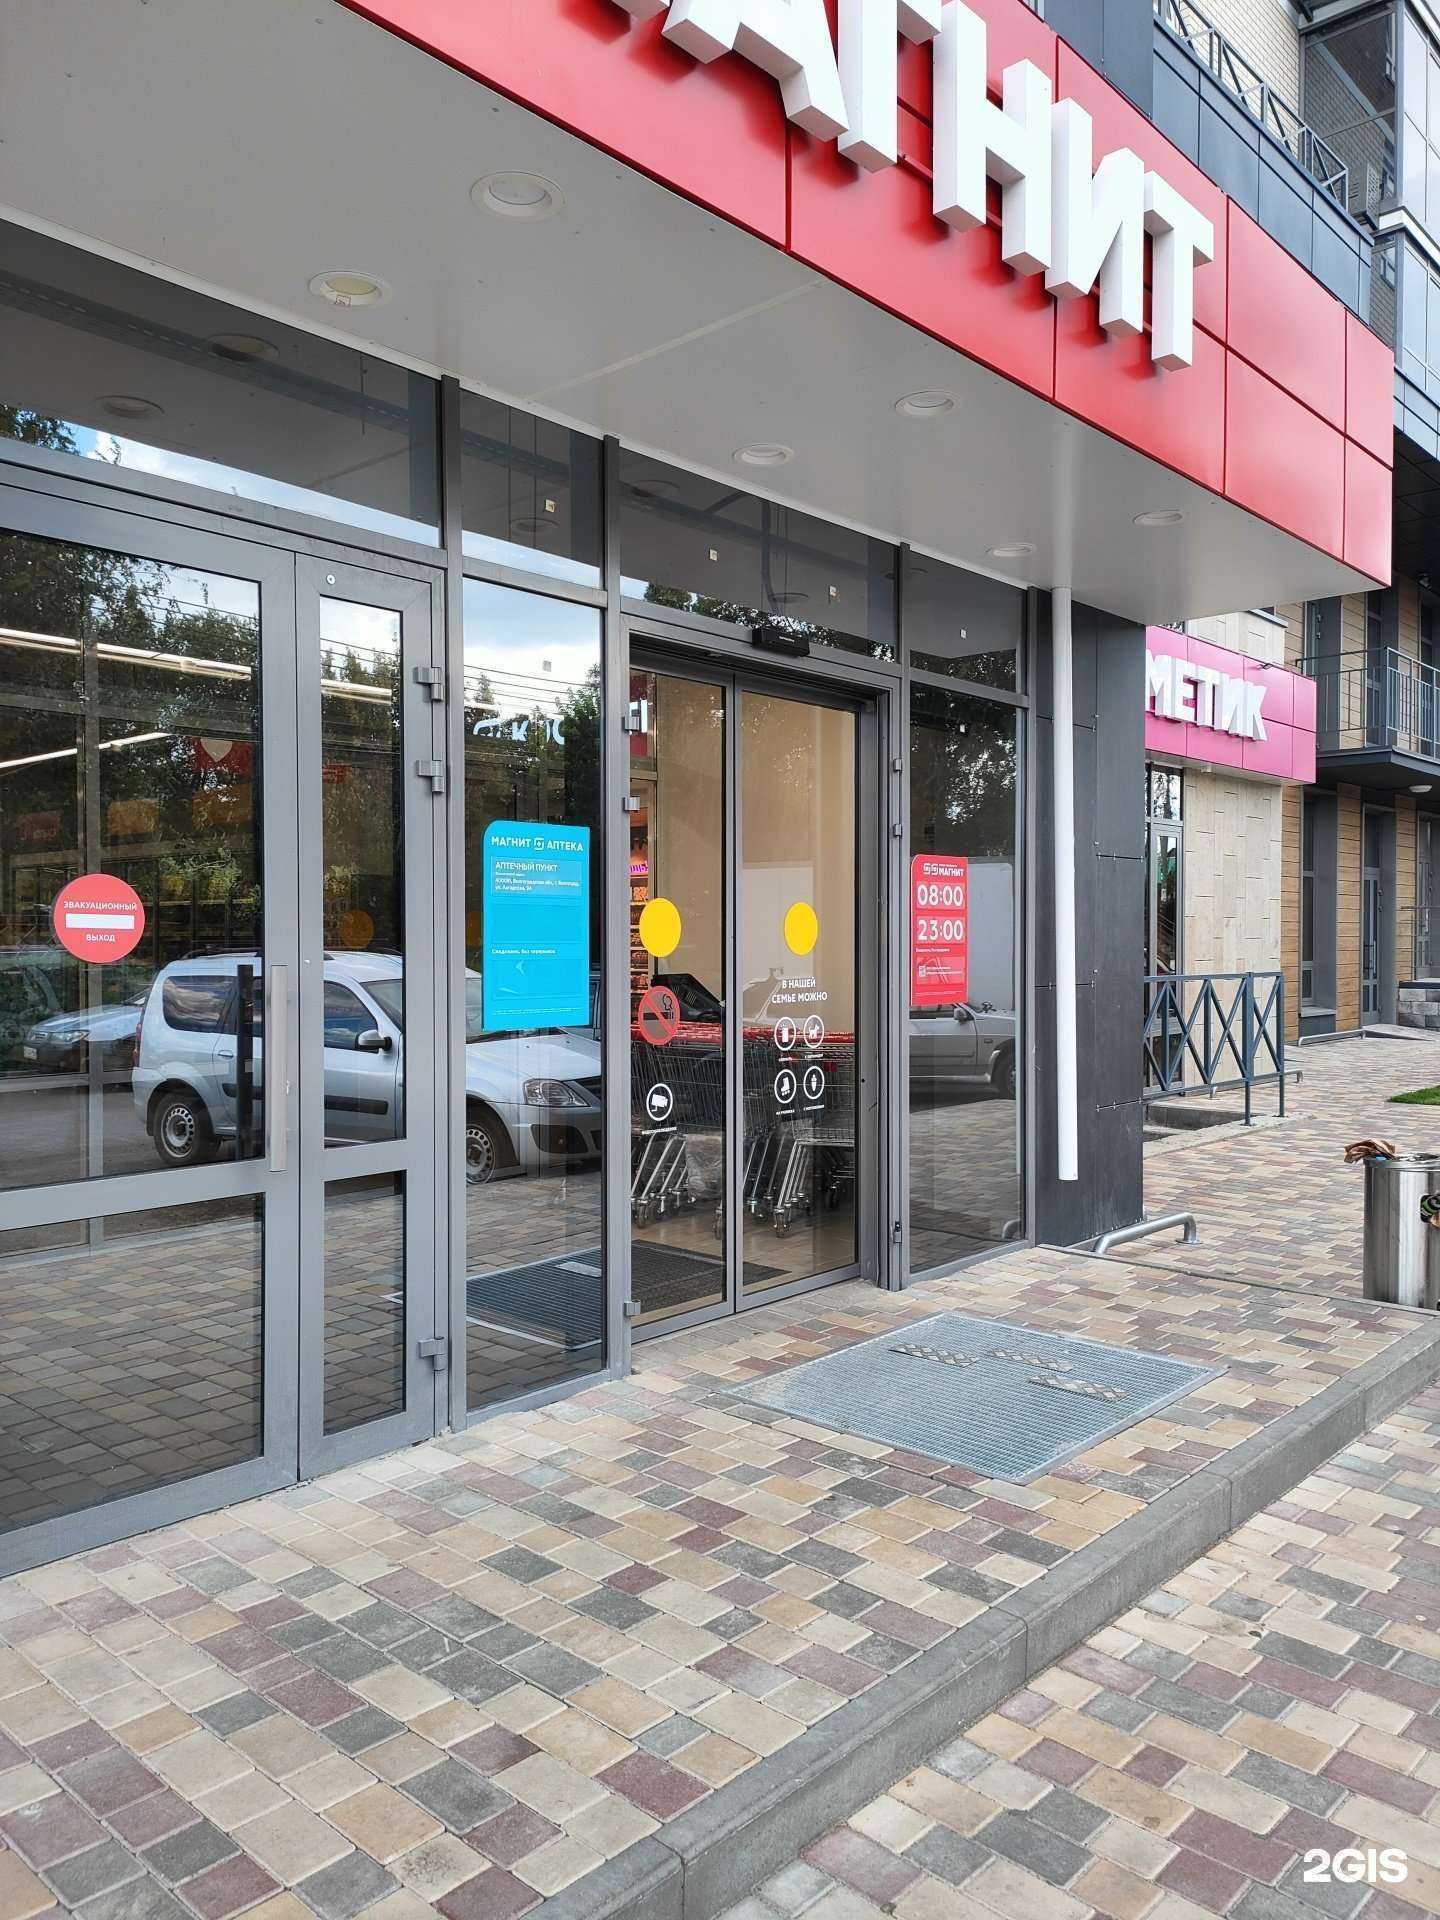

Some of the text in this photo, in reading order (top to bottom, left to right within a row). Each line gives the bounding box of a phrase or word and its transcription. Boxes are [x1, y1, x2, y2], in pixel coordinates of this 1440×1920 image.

[627, 0, 1213, 372] АГНИТ
[491, 836, 584, 852] МАГНИТ АПТЕКА
[495, 861, 557, 873] АПТЕЧНЫЙ ПУНКТ
[939, 867, 964, 878] МАГНИТ
[917, 884, 964, 907] 08:00
[63, 901, 138, 912] ЭВАКУАЦИОННЫЙ
[918, 919, 964, 941] 23:00
[86, 933, 116, 943] ВЫХОД
[782, 976, 817, 989] В НАШЕЙ
[771, 991, 828, 1004] СЕМЬЕ МОЖНО
